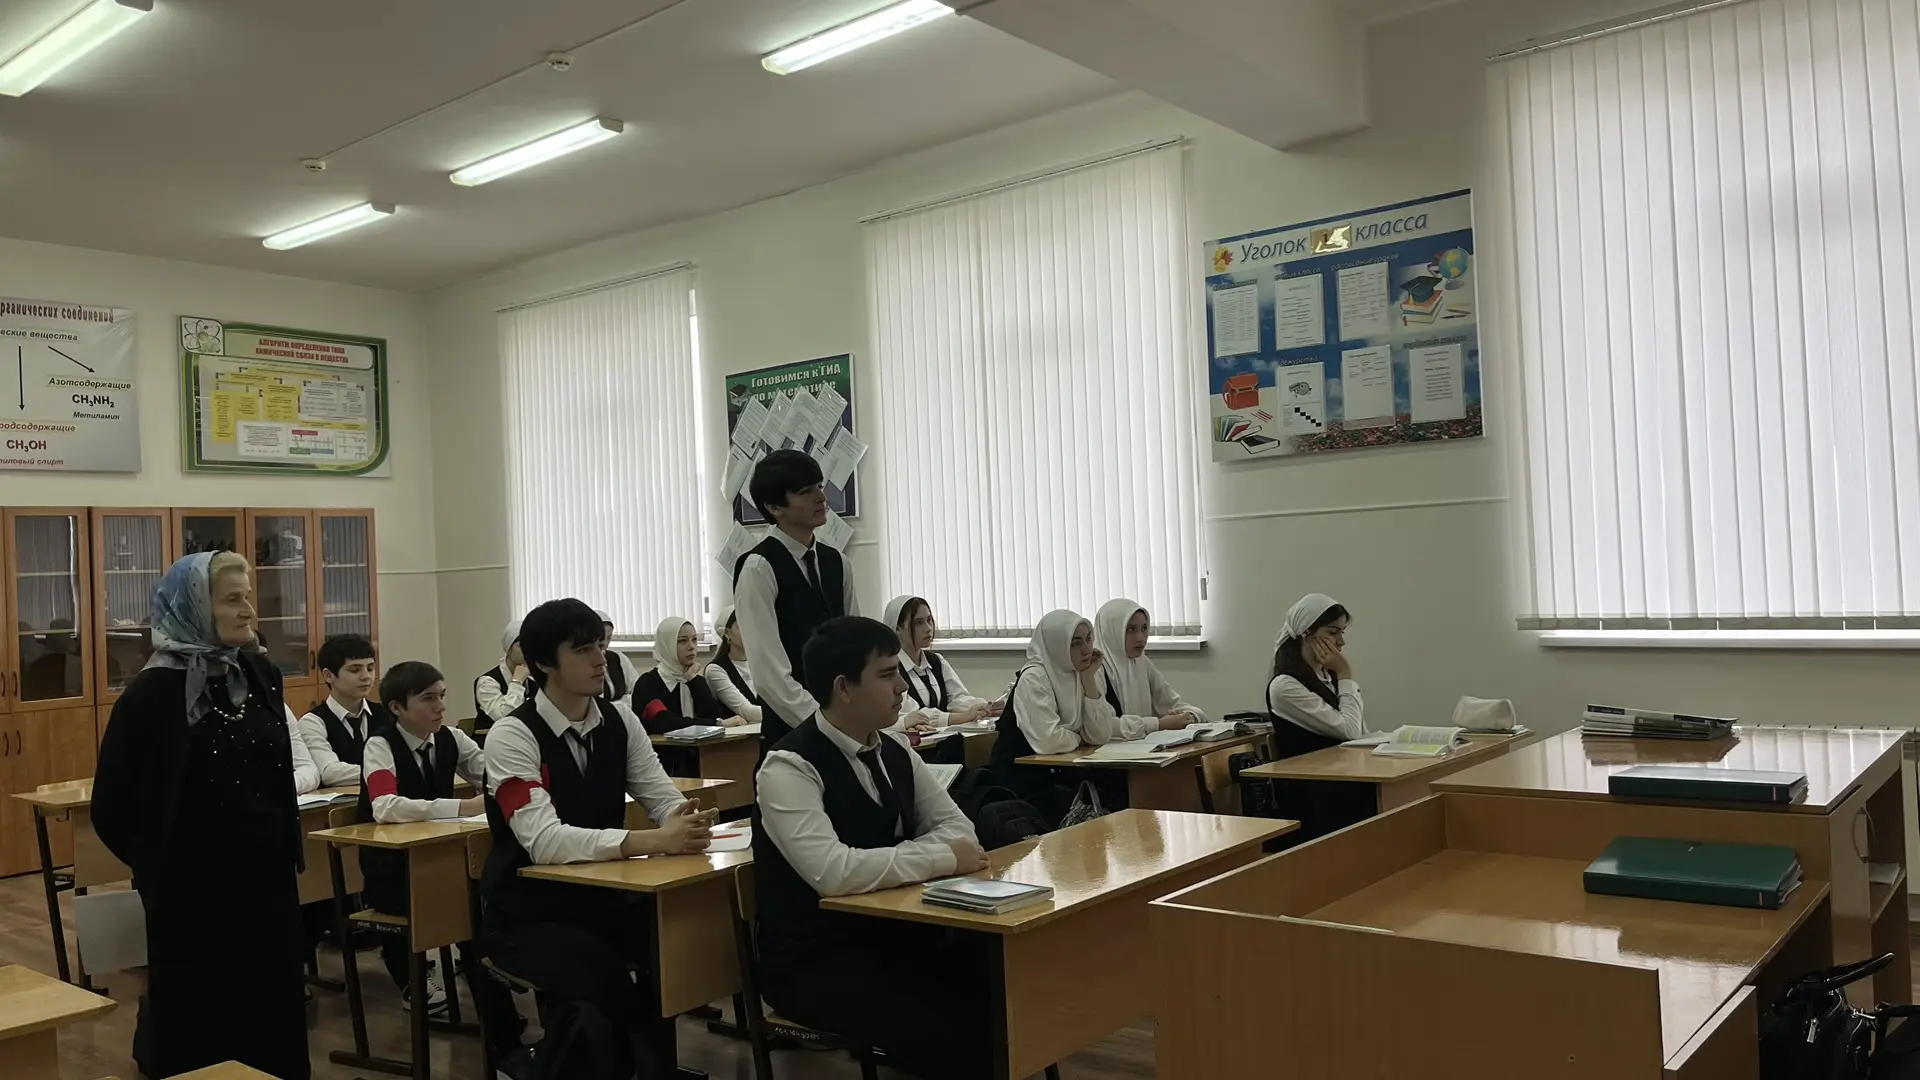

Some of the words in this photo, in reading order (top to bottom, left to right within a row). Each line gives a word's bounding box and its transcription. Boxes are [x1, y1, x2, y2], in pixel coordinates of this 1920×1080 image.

[1240, 236, 1308, 263] Уголок
[1354, 213, 1428, 241] класса
[0, 302, 58, 319] рганических
[61, 305, 114, 323] соединений
[30, 331, 78, 341] вещества
[48, 377, 131, 390] Азотсодержащие
[751, 373, 810, 388] Готовимся
[821, 364, 841, 376] ГИА
[73, 411, 120, 420] Метиламин
